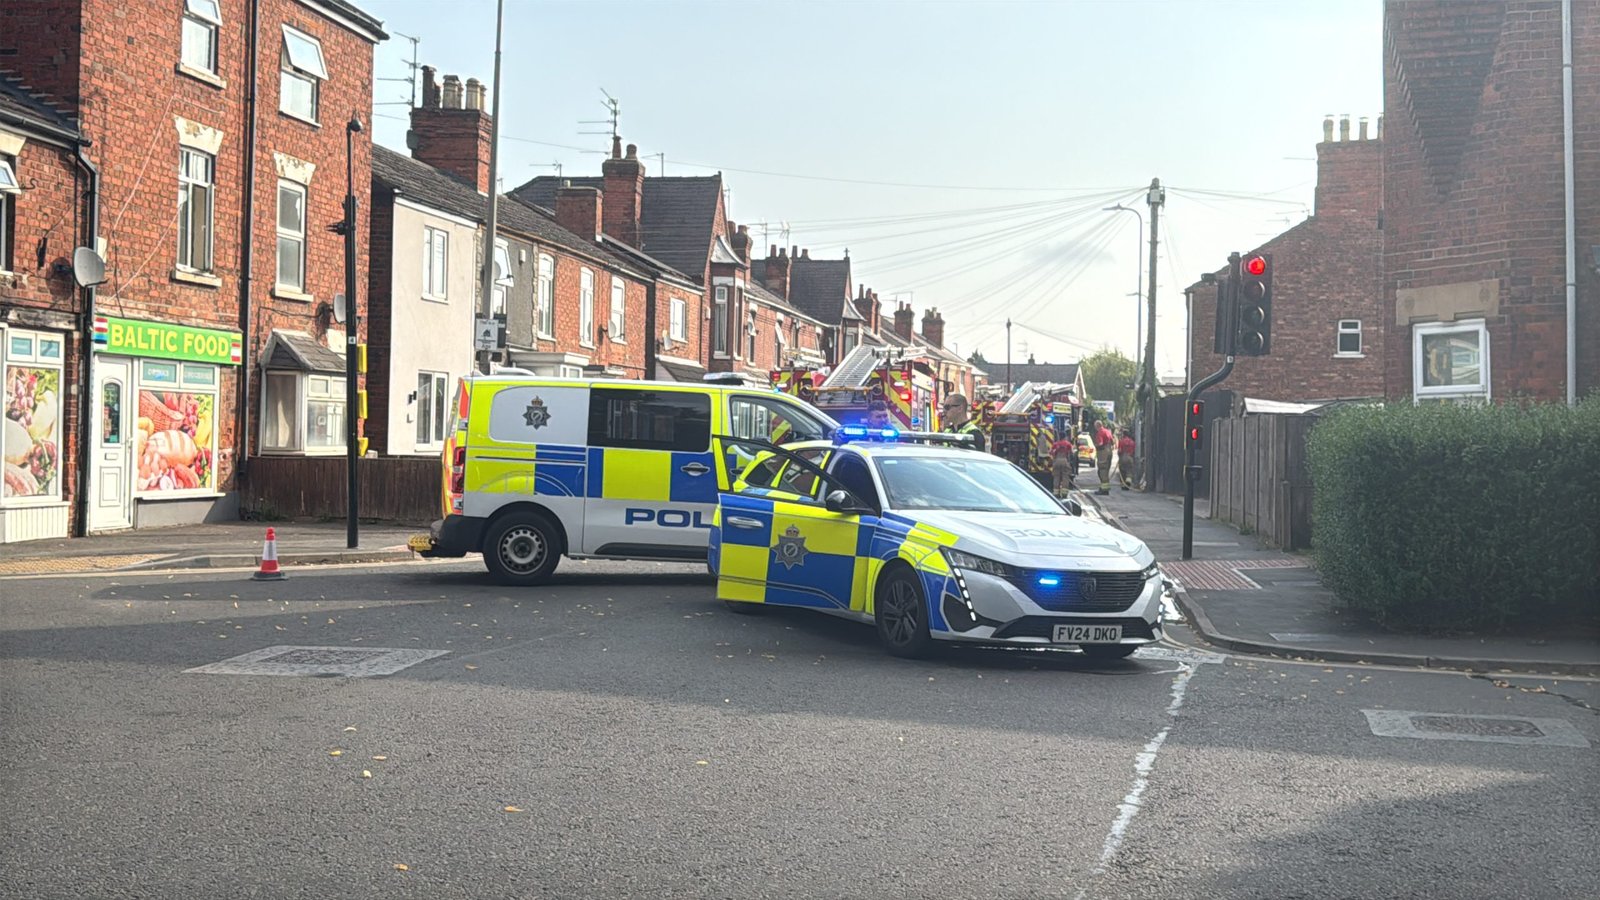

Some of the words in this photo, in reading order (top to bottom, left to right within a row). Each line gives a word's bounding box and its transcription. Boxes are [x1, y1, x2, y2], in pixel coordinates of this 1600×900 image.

[111, 324, 178, 352] BALTIC
[183, 332, 229, 357] FOOD
[1057, 627, 1090, 640] FV24
[1093, 627, 1117, 641] DKO
